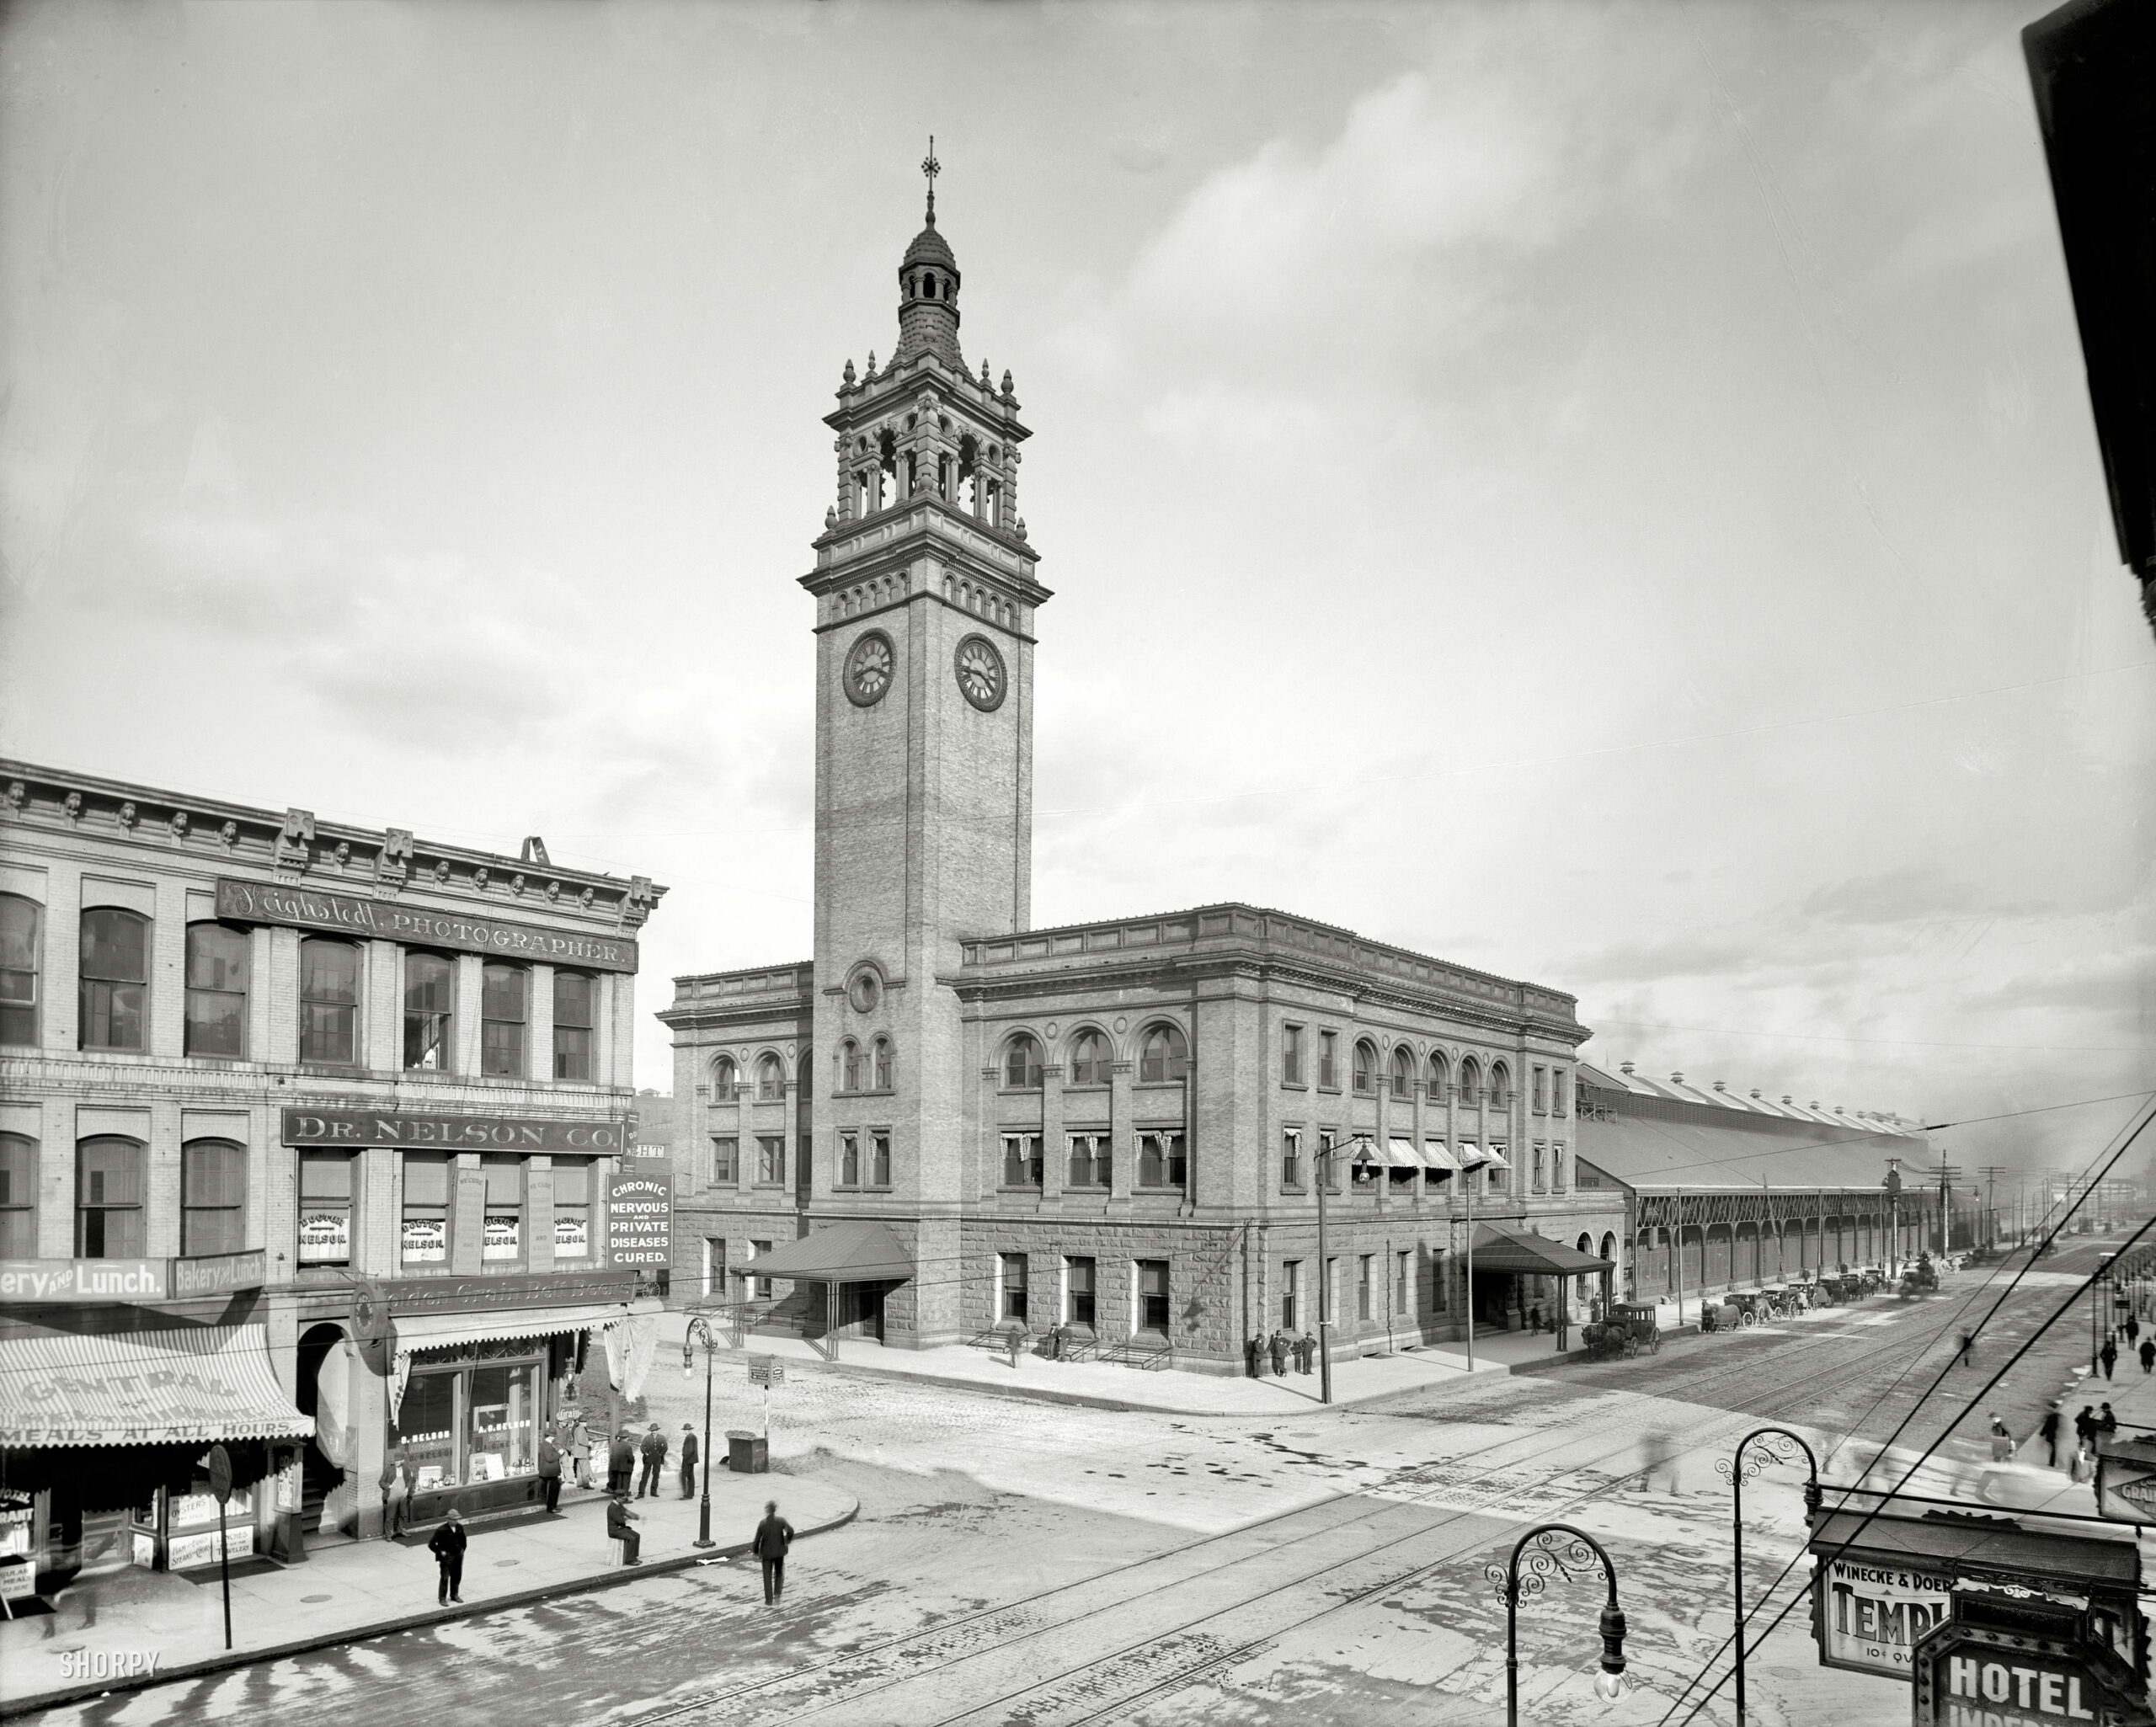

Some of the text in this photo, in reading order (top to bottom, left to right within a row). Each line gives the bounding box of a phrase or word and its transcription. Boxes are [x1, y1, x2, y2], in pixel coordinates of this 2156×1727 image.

[393, 914, 626, 963] PHOTOGRAPHER.
[296, 1116, 618, 1148] DR. NELSON CO.
[611, 1181, 667, 1197] CHRONIC
[610, 1202, 669, 1213] NERVOUS
[299, 1213, 345, 1228] DOCTOR
[402, 1219, 442, 1233] DOCTOR
[485, 1217, 516, 1230] OCTOR
[555, 1217, 584, 1229] OCTOR
[610, 1221, 669, 1233] PRIVATE
[611, 1237, 669, 1249] DISEASES
[614, 1251, 667, 1263] CURED.
[77, 1264, 162, 1294] Lunch.
[176, 1263, 221, 1291] Bakery
[383, 1279, 630, 1308] olden Grain Belt Beers
[0, 1429, 103, 1442] MEALS
[164, 1426, 209, 1438] ALL
[171, 1497, 206, 1518] OYSTERS
[216, 1531, 248, 1543] LNCHES
[216, 1545, 249, 1556] TAVELERS
[1833, 1562, 1894, 1586] WINECKE
[1898, 1573, 1909, 1588] &
[1949, 1655, 2094, 1720] HOTEL
